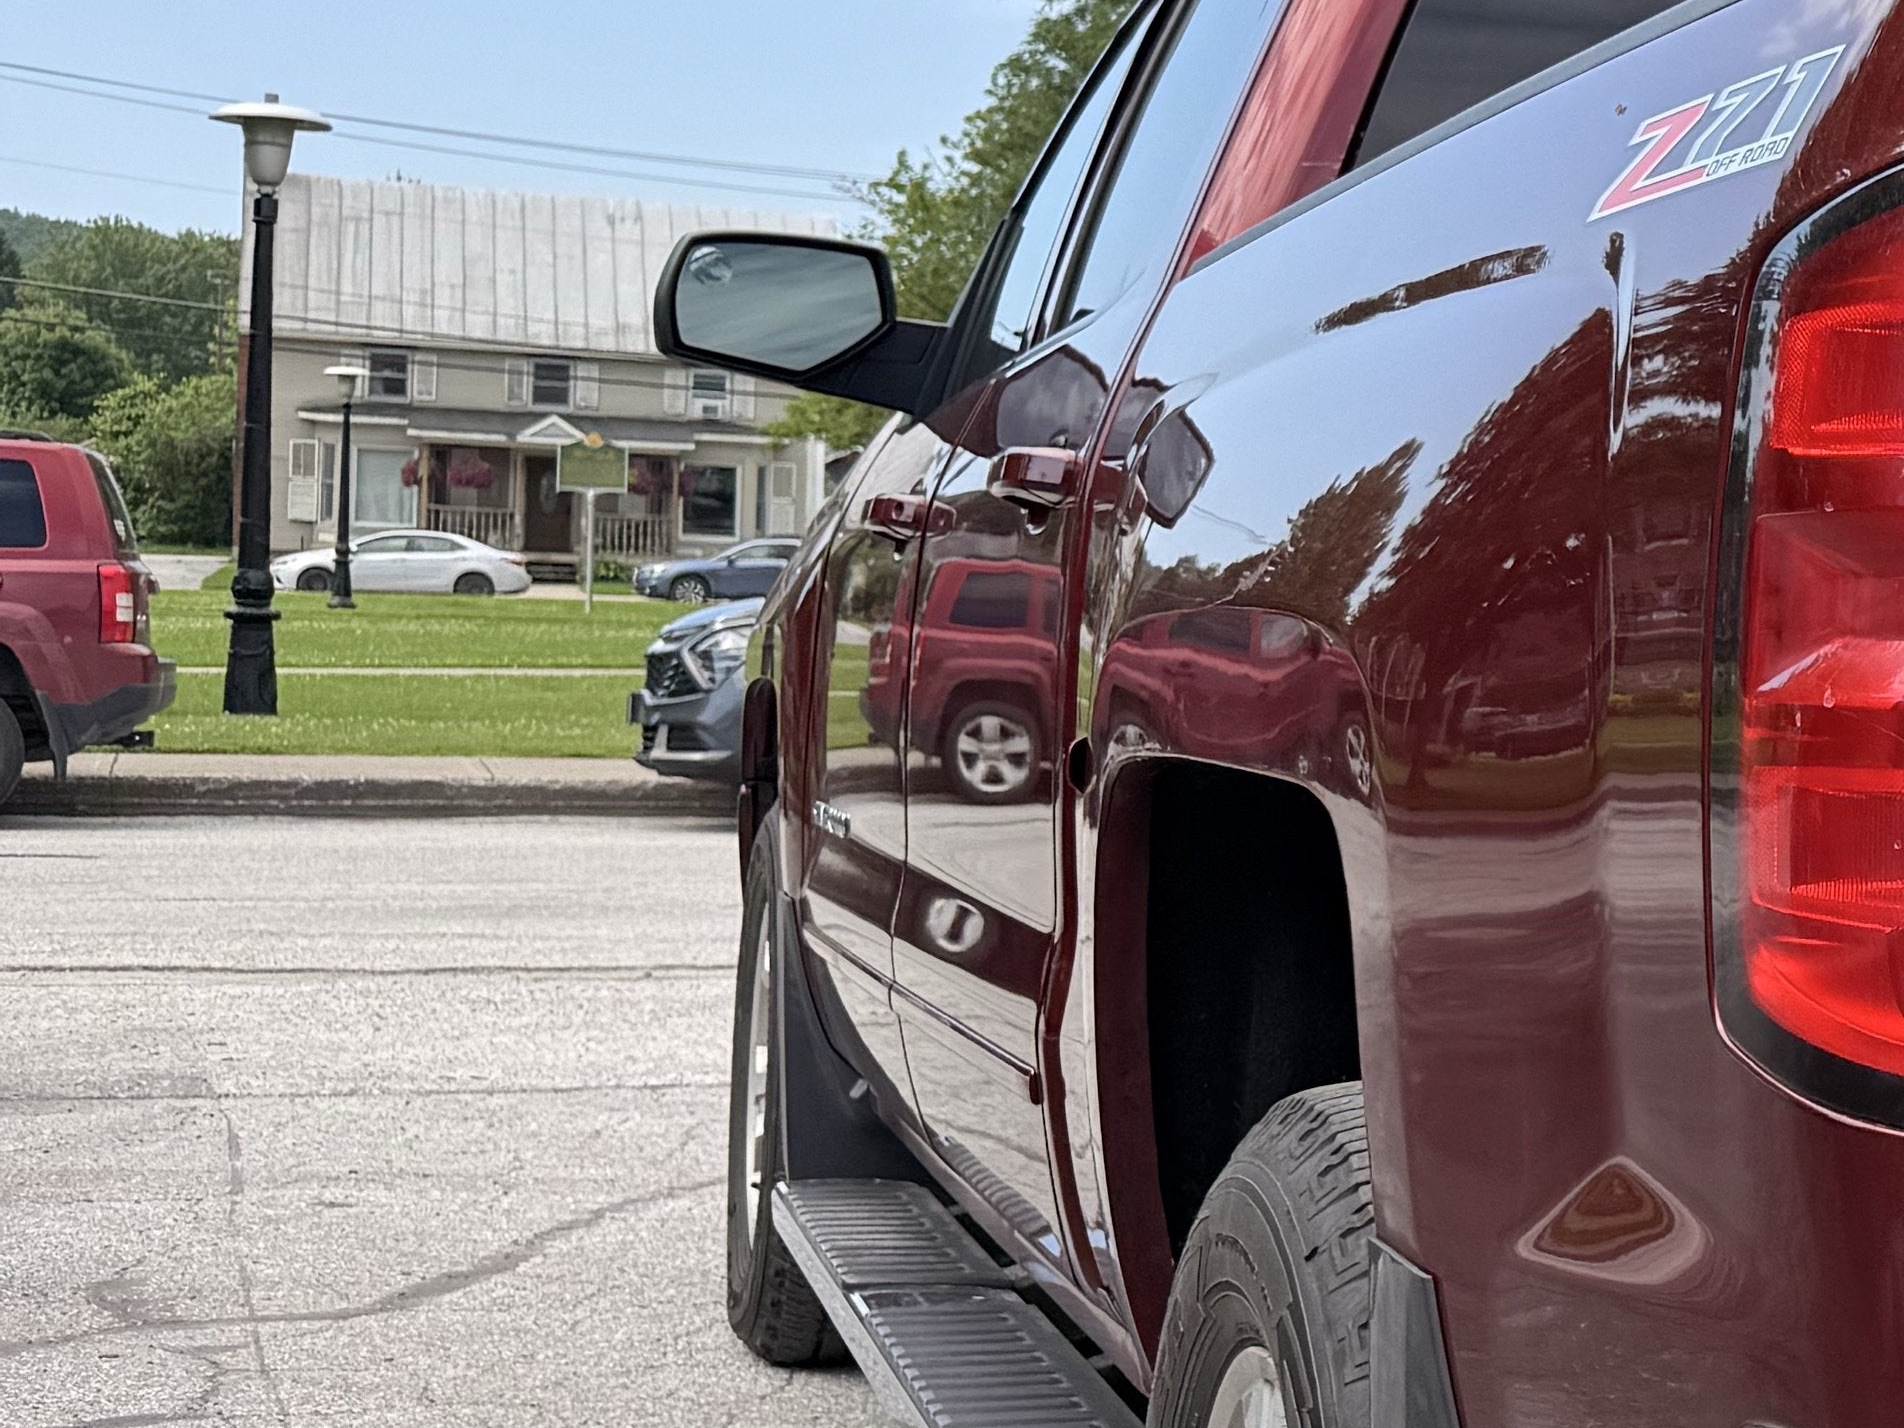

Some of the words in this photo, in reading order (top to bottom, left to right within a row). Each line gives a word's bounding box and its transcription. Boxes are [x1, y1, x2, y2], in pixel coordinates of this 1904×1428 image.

[1586, 44, 1847, 222] Z71
[1706, 154, 1740, 177] OFF
[1739, 138, 1789, 166] ROAD
